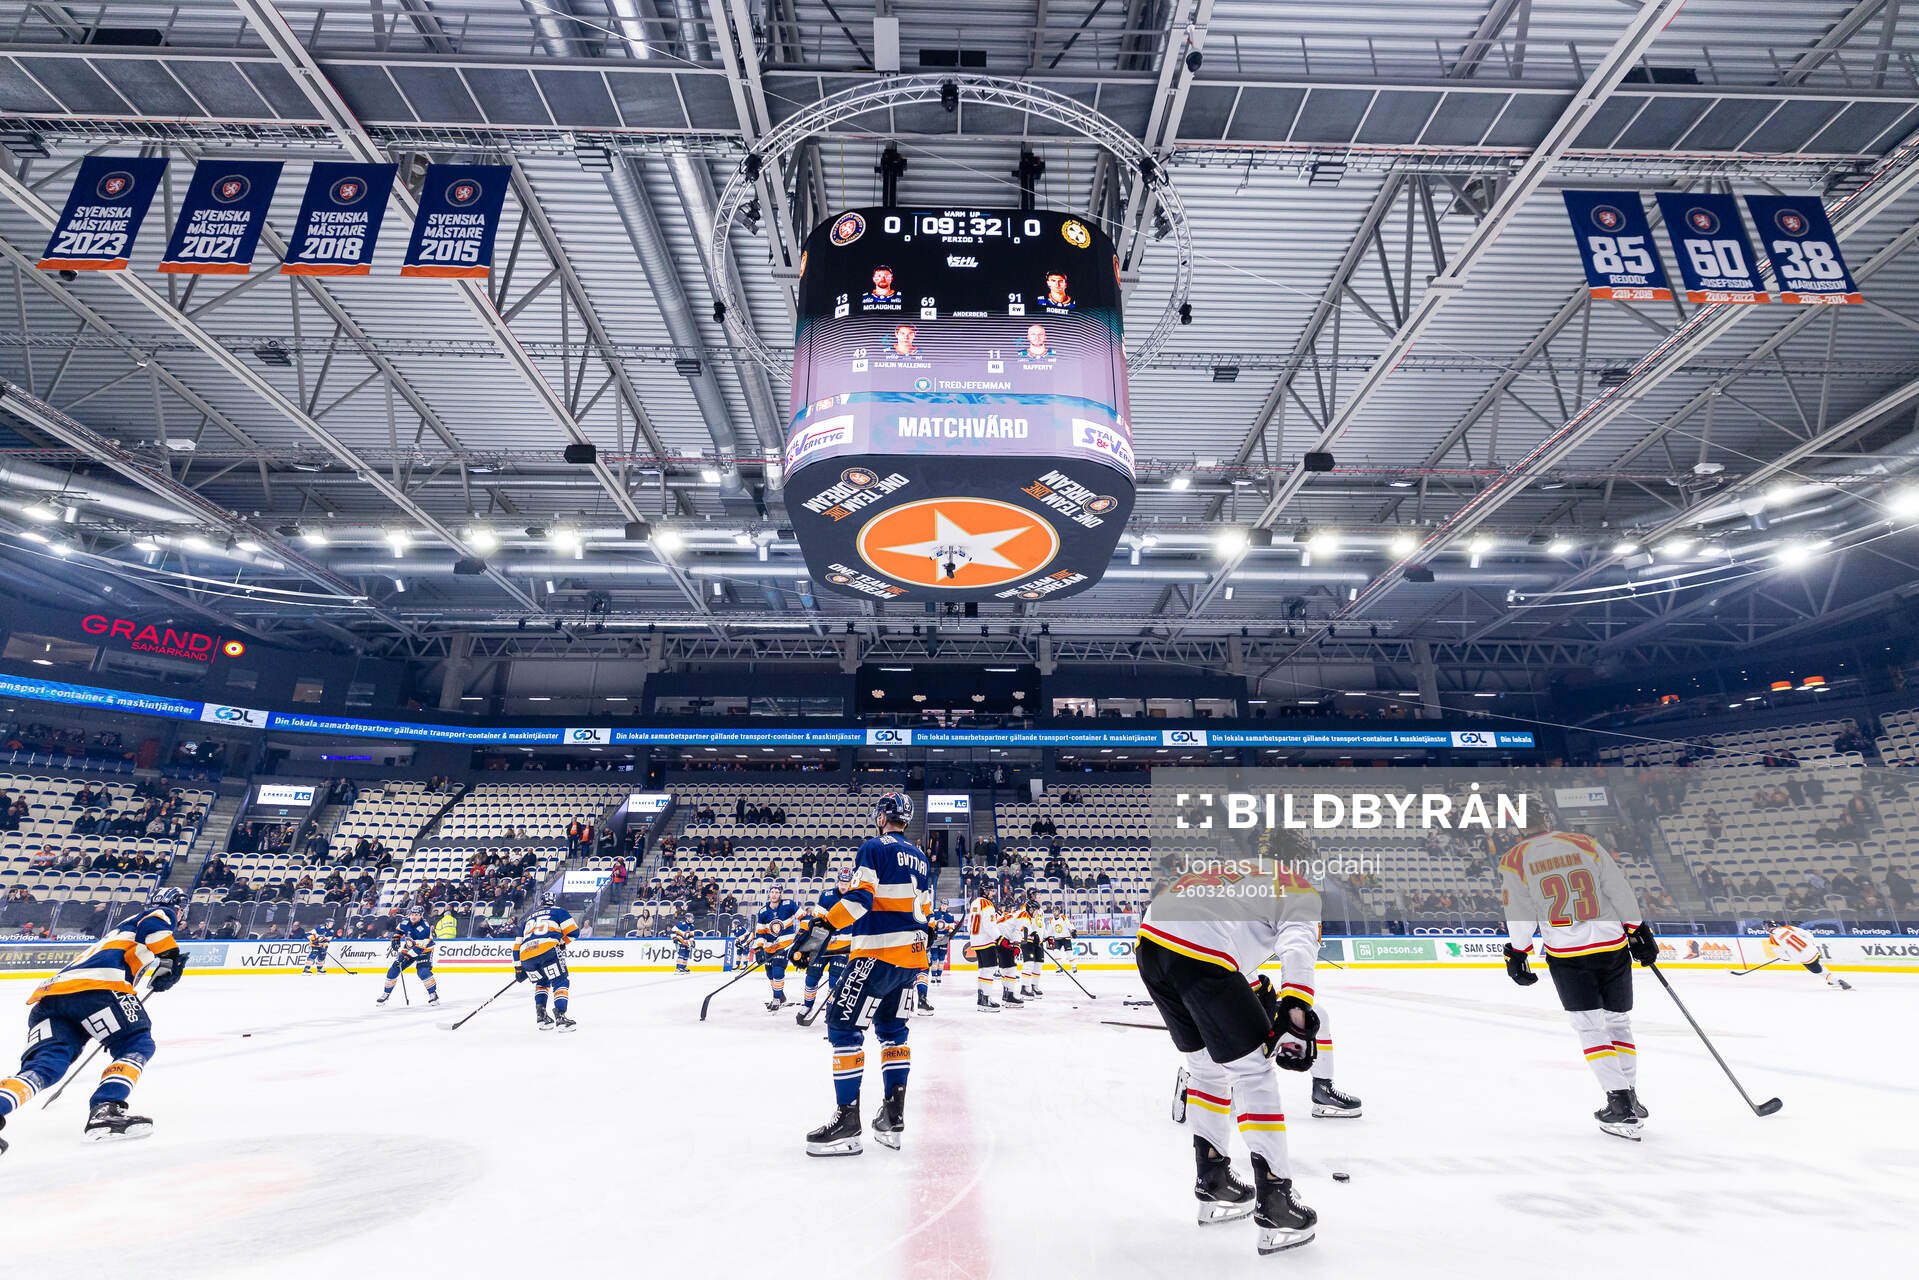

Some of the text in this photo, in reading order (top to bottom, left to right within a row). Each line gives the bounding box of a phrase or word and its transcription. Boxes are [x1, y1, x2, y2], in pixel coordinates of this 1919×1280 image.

[74, 206, 132, 218] SVENSKA
[191, 209, 250, 222] SVENSKA
[310, 211, 369, 224] SVENSKA
[428, 213, 486, 226] SVENSKA
[67, 217, 128, 232] MÄSTARE
[187, 221, 246, 236] MÄSTARE
[307, 223, 367, 237] MÄSTARE
[423, 225, 483, 239] MÄSTARE
[884, 216, 901, 234] 0
[922, 217, 1003, 236] 09:32
[1024, 219, 1040, 236] 0
[52, 231, 124, 255] 2023
[177, 236, 240, 258] 2021
[299, 238, 363, 260] 2018
[418, 240, 480, 261] 2015
[1587, 235, 1655, 273] 85
[1683, 239, 1749, 278] 60
[1772, 240, 1844, 279] 38
[836, 294, 848, 305] 13
[921, 297, 935, 306] 69
[1008, 293, 1022, 303] 91
[1046, 307, 1069, 315] ROBERT
[852, 348, 867, 358] 49
[939, 381, 1011, 390] TREDJEFEMMAN
[875, 473, 910, 494] ONE
[840, 490, 883, 512] TEAM
[1040, 492, 1081, 516] TEAM
[1072, 511, 1104, 528] ONE
[828, 563, 859, 576] ONE
[856, 574, 892, 589] TEAM
[1018, 577, 1056, 590] TEAM
[82, 615, 212, 651] GRAND
[132, 641, 208, 662] SAMARKAND
[0, 681, 103, 704] ansport-container
[117, 697, 195, 715] maskintjänster
[215, 707, 254, 723] GDL
[275, 717, 289, 726] Din
[292, 718, 317, 727] lokala
[320, 721, 391, 734] samarbetspartner
[394, 726, 428, 737] gällande
[430, 730, 500, 740] transport-container
[509, 732, 559, 741] maskintjänster
[573, 730, 600, 741] GDL
[650, 733, 709, 741] samarbetspartner
[710, 732, 738, 741] gällande
[740, 733, 803, 741] transport-container
[812, 733, 861, 741] maskintjänster
[875, 730, 902, 741] GDL
[929, 733, 949, 741] lokala
[951, 734, 1008, 742] samarbetspartner
[1010, 733, 1038, 742] gällande
[1039, 734, 1100, 742] transport-container
[1109, 734, 1157, 742] maskintjänster
[1171, 732, 1198, 742] GDL
[1224, 734, 1244, 742] lokala
[1246, 735, 1300, 743] samarbetspartner
[1303, 735, 1330, 744] gällande
[1331, 735, 1392, 743] transport-container
[1400, 735, 1447, 744] maskintjänster
[1460, 733, 1487, 744] GDL
[1529, 852, 1583, 876] LINDBLOM
[1541, 869, 1600, 927] 23
[340, 944, 381, 960] Kinnarps
[439, 943, 512, 957] Sandbäcke
[560, 949, 625, 958] ÄXJÖ BUSS
[1377, 945, 1424, 956] pacson.se
[1464, 944, 1483, 953] SAM
[242, 955, 308, 967] WELLNE
[837, 959, 864, 1009] NORDIC
